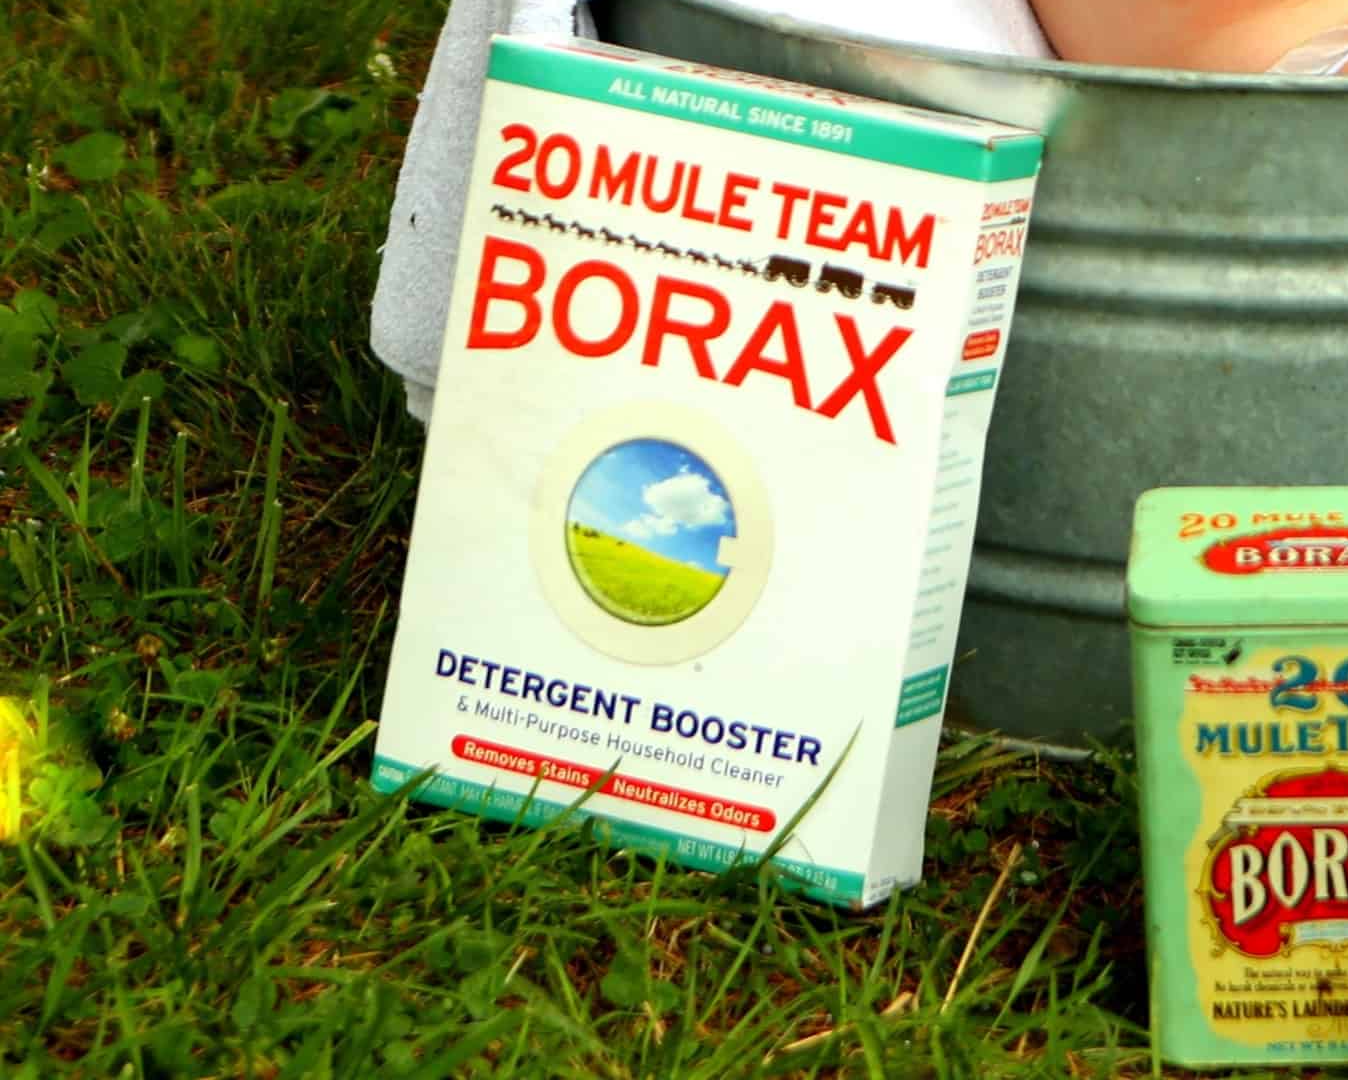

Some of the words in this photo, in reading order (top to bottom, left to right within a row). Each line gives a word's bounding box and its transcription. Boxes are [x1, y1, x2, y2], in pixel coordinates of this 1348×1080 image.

[608, 76, 645, 99] ALL
[653, 87, 741, 121] NATURAL
[749, 107, 806, 133] SINCE
[811, 119, 853, 144] 1891
[491, 123, 582, 200] 20
[588, 142, 761, 232] MULE
[770, 181, 937, 269] TEAM
[974, 228, 1024, 264] BORAX
[466, 234, 914, 446] BORAX
[1178, 512, 1239, 539] 20
[1251, 511, 1344, 525] MULE
[435, 648, 642, 725] DETERGENT
[650, 702, 824, 766] BOOSTER
[456, 695, 470, 713] &
[474, 700, 601, 748] Multi-Purpose
[606, 731, 705, 771] Household
[711, 757, 785, 789] Cleaner
[462, 741, 536, 774] Removes
[541, 759, 591, 786] Stains
[612, 778, 707, 815] Neutralizes
[711, 801, 761, 828] Odors
[1212, 1000, 1288, 1019] NATURE'S
